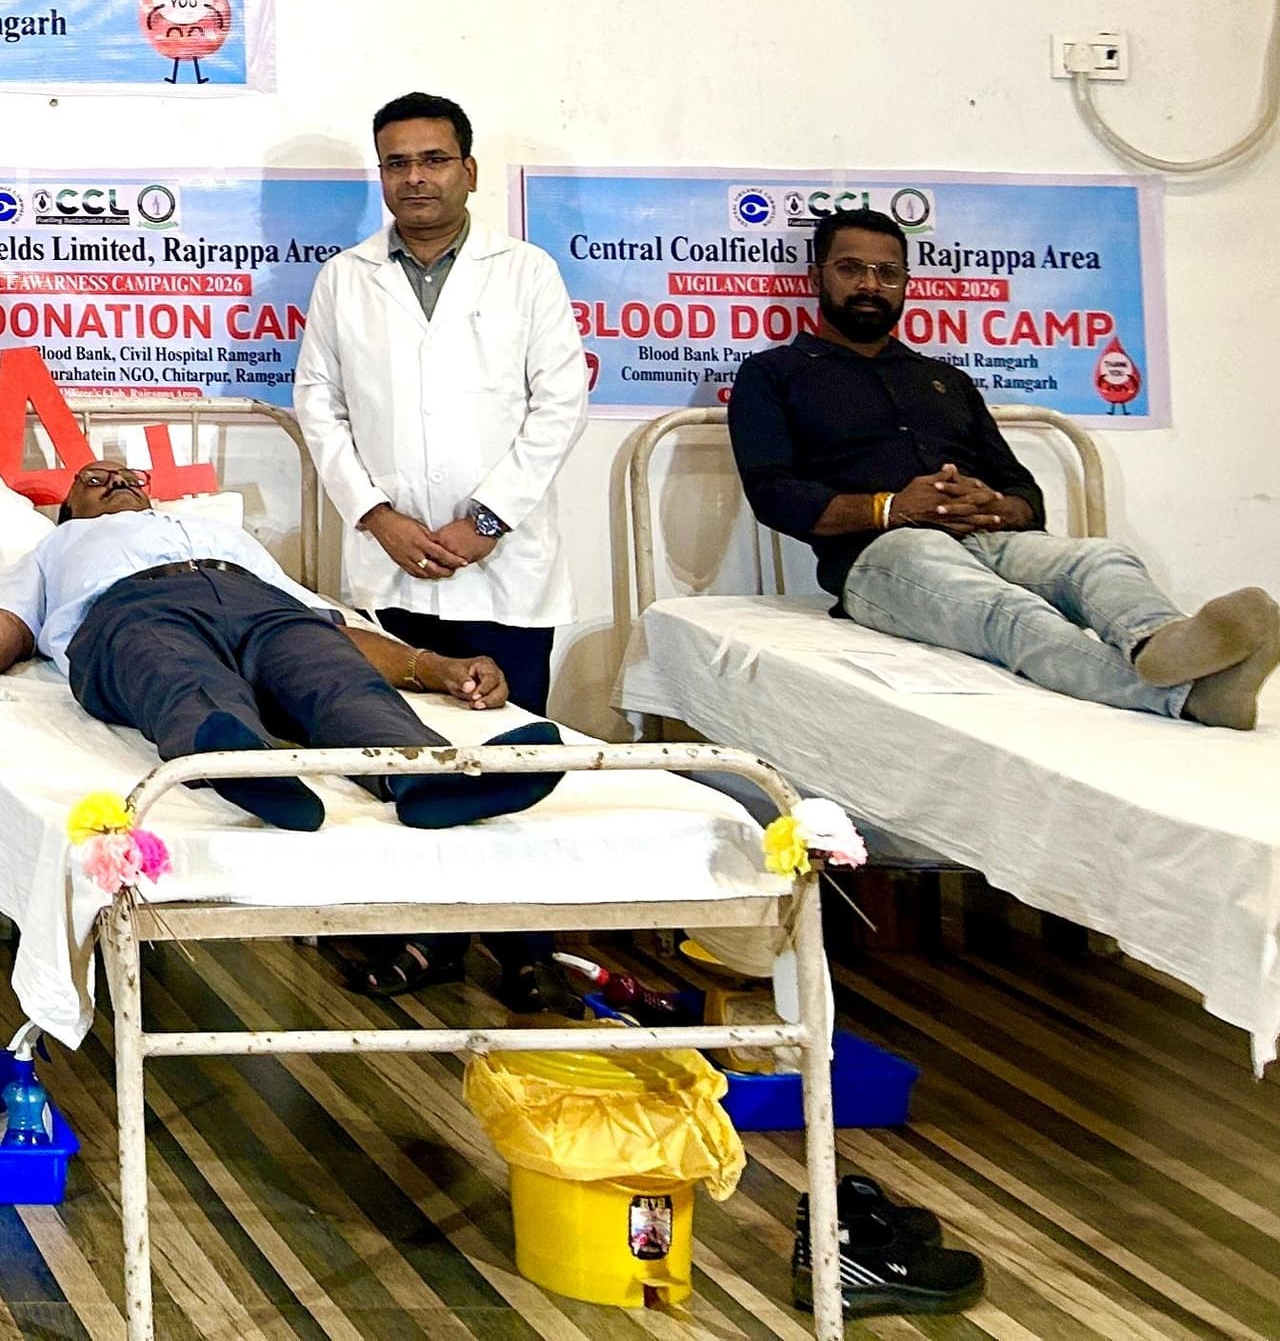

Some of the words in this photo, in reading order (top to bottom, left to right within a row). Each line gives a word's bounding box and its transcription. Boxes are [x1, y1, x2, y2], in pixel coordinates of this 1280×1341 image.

[56, 189, 129, 215] CCL
[52, 236, 154, 267] Limited,
[163, 237, 280, 270] Rajrappa
[570, 234, 662, 261] Central
[671, 235, 797, 263] Coalfields
[917, 240, 1036, 275] Rajrappa
[1041, 244, 1102, 269] Area
[20, 274, 110, 291] AWARNESS
[112, 275, 201, 292] CAMPAIGN
[204, 276, 243, 293] 2026
[675, 275, 769, 293] VIGILANCE
[907, 280, 957, 297] PAIGN
[961, 280, 1000, 297] 2026
[982, 310, 1114, 347] CAMP
[76, 346, 116, 362] Bank,
[120, 346, 151, 361] Civil
[155, 346, 214, 365] Hospital
[218, 347, 281, 366] Ramgarh
[639, 345, 679, 361] Blood
[684, 347, 719, 362] Bank
[974, 351, 1039, 370] Ramgarh
[51, 366, 116, 381] urahatein
[120, 367, 159, 383] NGO,
[162, 367, 232, 386] Chitarpur,
[622, 366, 700, 385] Community
[993, 374, 1057, 392] Ramgarh
